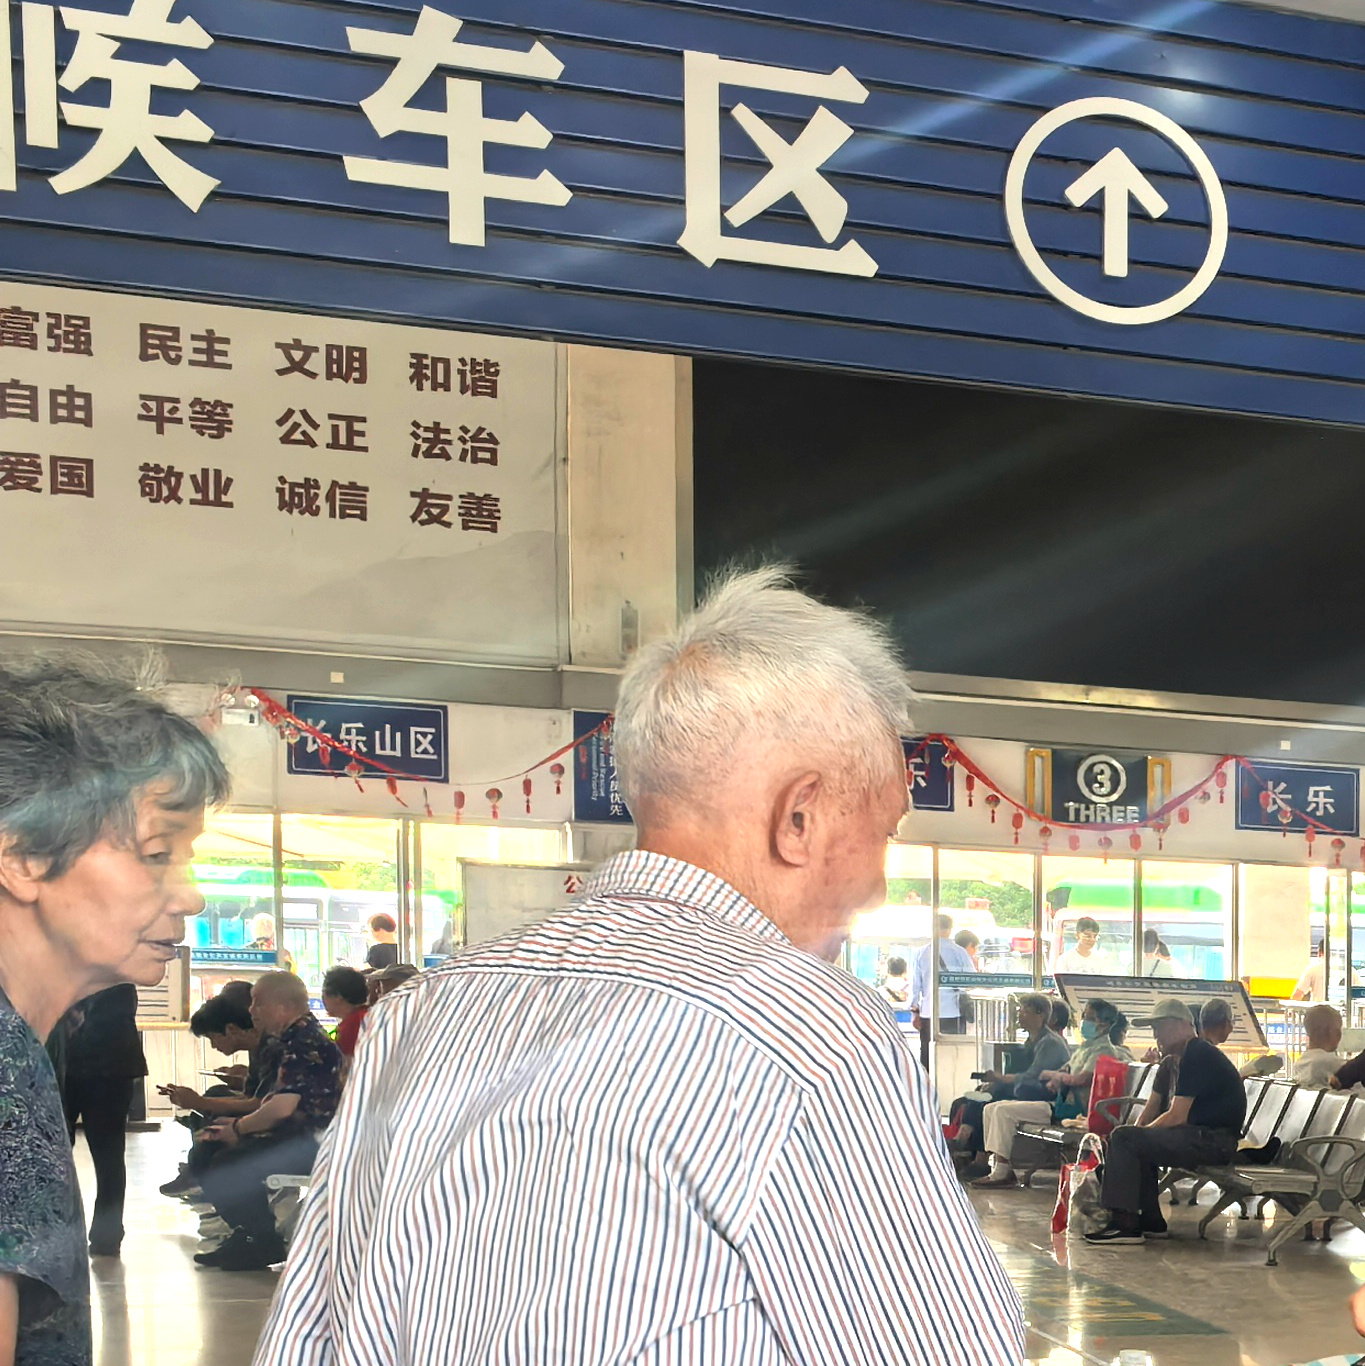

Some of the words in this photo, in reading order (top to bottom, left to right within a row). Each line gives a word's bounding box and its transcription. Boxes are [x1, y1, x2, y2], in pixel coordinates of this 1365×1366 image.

[0, 305, 94, 357] 富强
[138, 322, 233, 370] 民主
[274, 338, 368, 385] 文明
[409, 352, 500, 399] 和谐
[0, 378, 94, 429] 自由
[137, 393, 234, 440] 平等
[275, 407, 369, 453] 公正
[409, 419, 500, 466] 法治
[0, 451, 95, 499] 爱国
[138, 462, 234, 509] 敬业
[275, 475, 370, 522] 诚信
[409, 487, 501, 534] 友善
[300, 717, 438, 760] 长乐山区
[1064, 800, 1140, 824] THREE
[1266, 780, 1336, 817] 长乐
